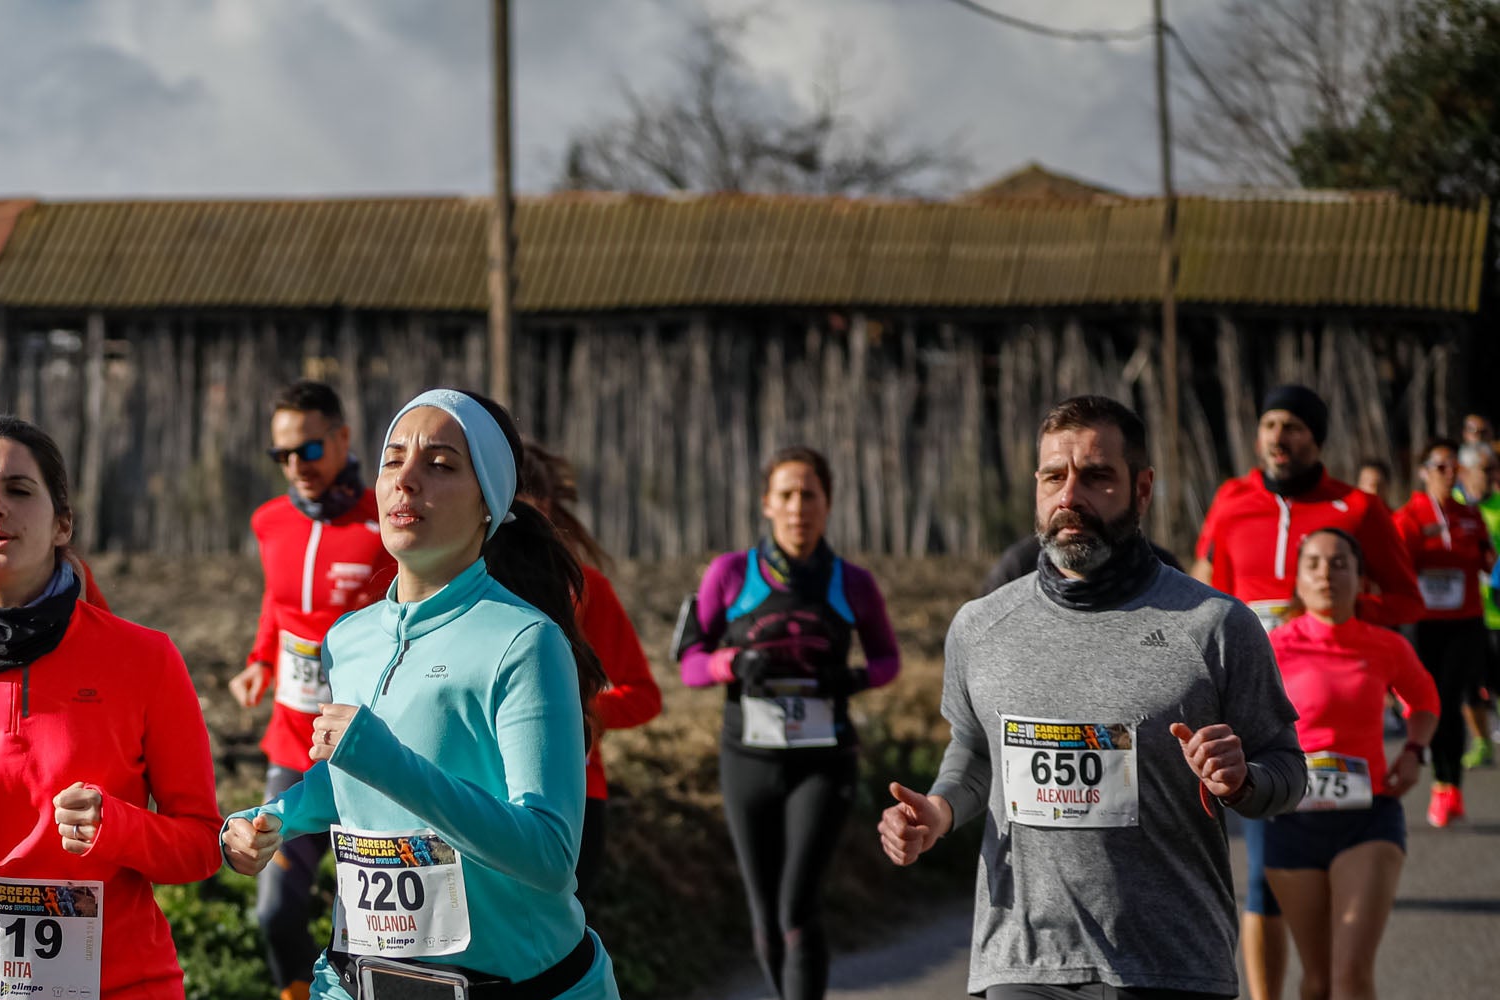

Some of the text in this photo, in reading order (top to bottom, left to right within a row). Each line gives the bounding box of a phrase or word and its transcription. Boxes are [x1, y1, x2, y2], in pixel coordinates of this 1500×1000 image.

[1007, 722, 1018, 733] 26
[1034, 724, 1082, 734] CARRERA
[1035, 732, 1081, 741] POPULAR
[1031, 751, 1102, 786] 650
[1036, 787, 1100, 804] ALEXVILLOS
[357, 869, 425, 912] 220
[366, 914, 417, 932] YOLANDA
[386, 937, 415, 946] olimpo
[3, 961, 32, 979] RITA
[12, 982, 44, 993] olimpo
